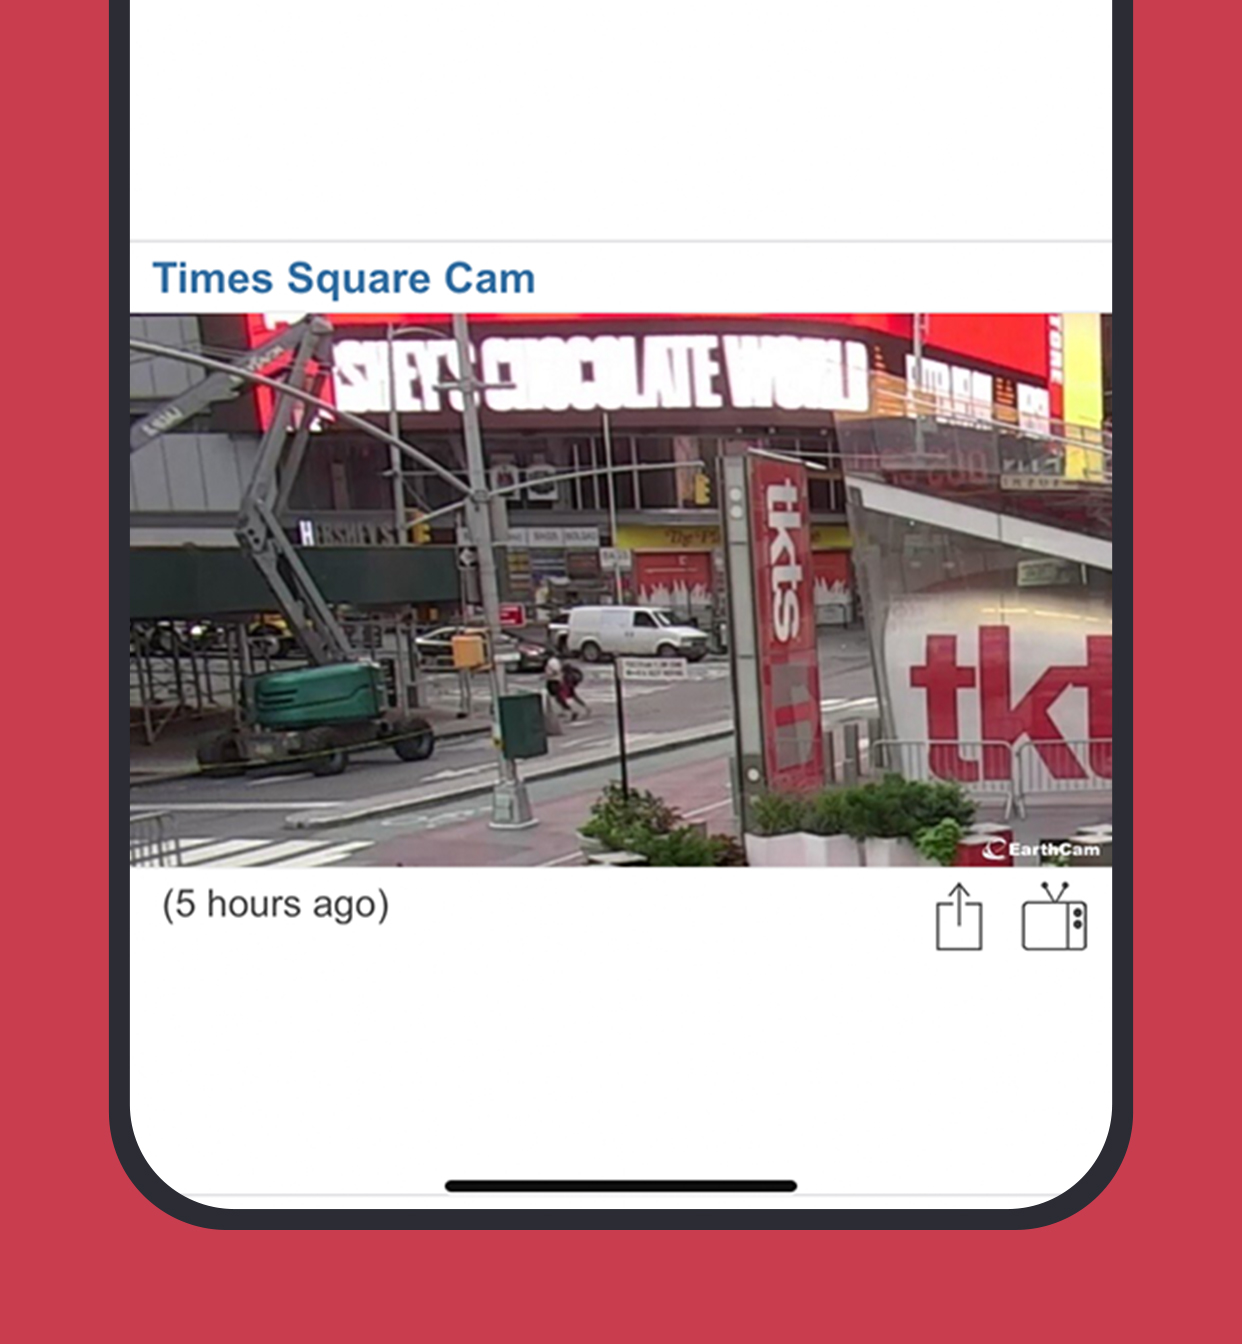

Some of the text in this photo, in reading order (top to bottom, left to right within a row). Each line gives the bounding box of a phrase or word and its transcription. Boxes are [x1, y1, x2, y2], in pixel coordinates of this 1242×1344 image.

[152, 261, 534, 302] Times Square Cam
[481, 335, 723, 412] CHOCOLATE
[766, 478, 803, 642] tkts
[163, 888, 388, 926] (5 hours ago)
